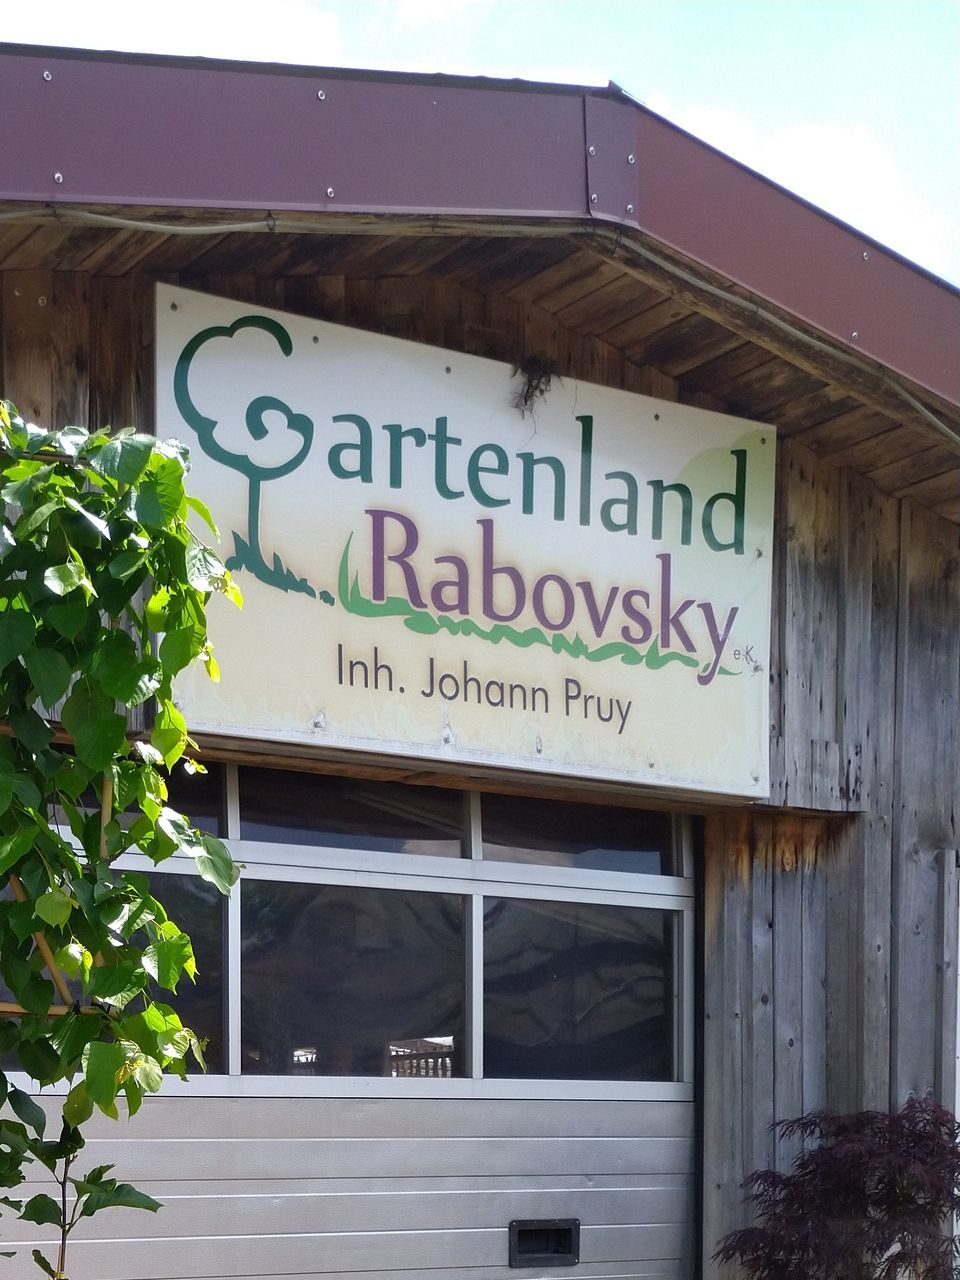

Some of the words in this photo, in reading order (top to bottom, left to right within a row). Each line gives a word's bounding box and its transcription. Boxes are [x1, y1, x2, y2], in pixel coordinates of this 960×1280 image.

[174, 315, 745, 556] Gartenland
[364, 508, 740, 687] Rabovsky
[337, 644, 405, 694] Inh.
[421, 657, 550, 714] Johann
[565, 677, 633, 735] Pruy
